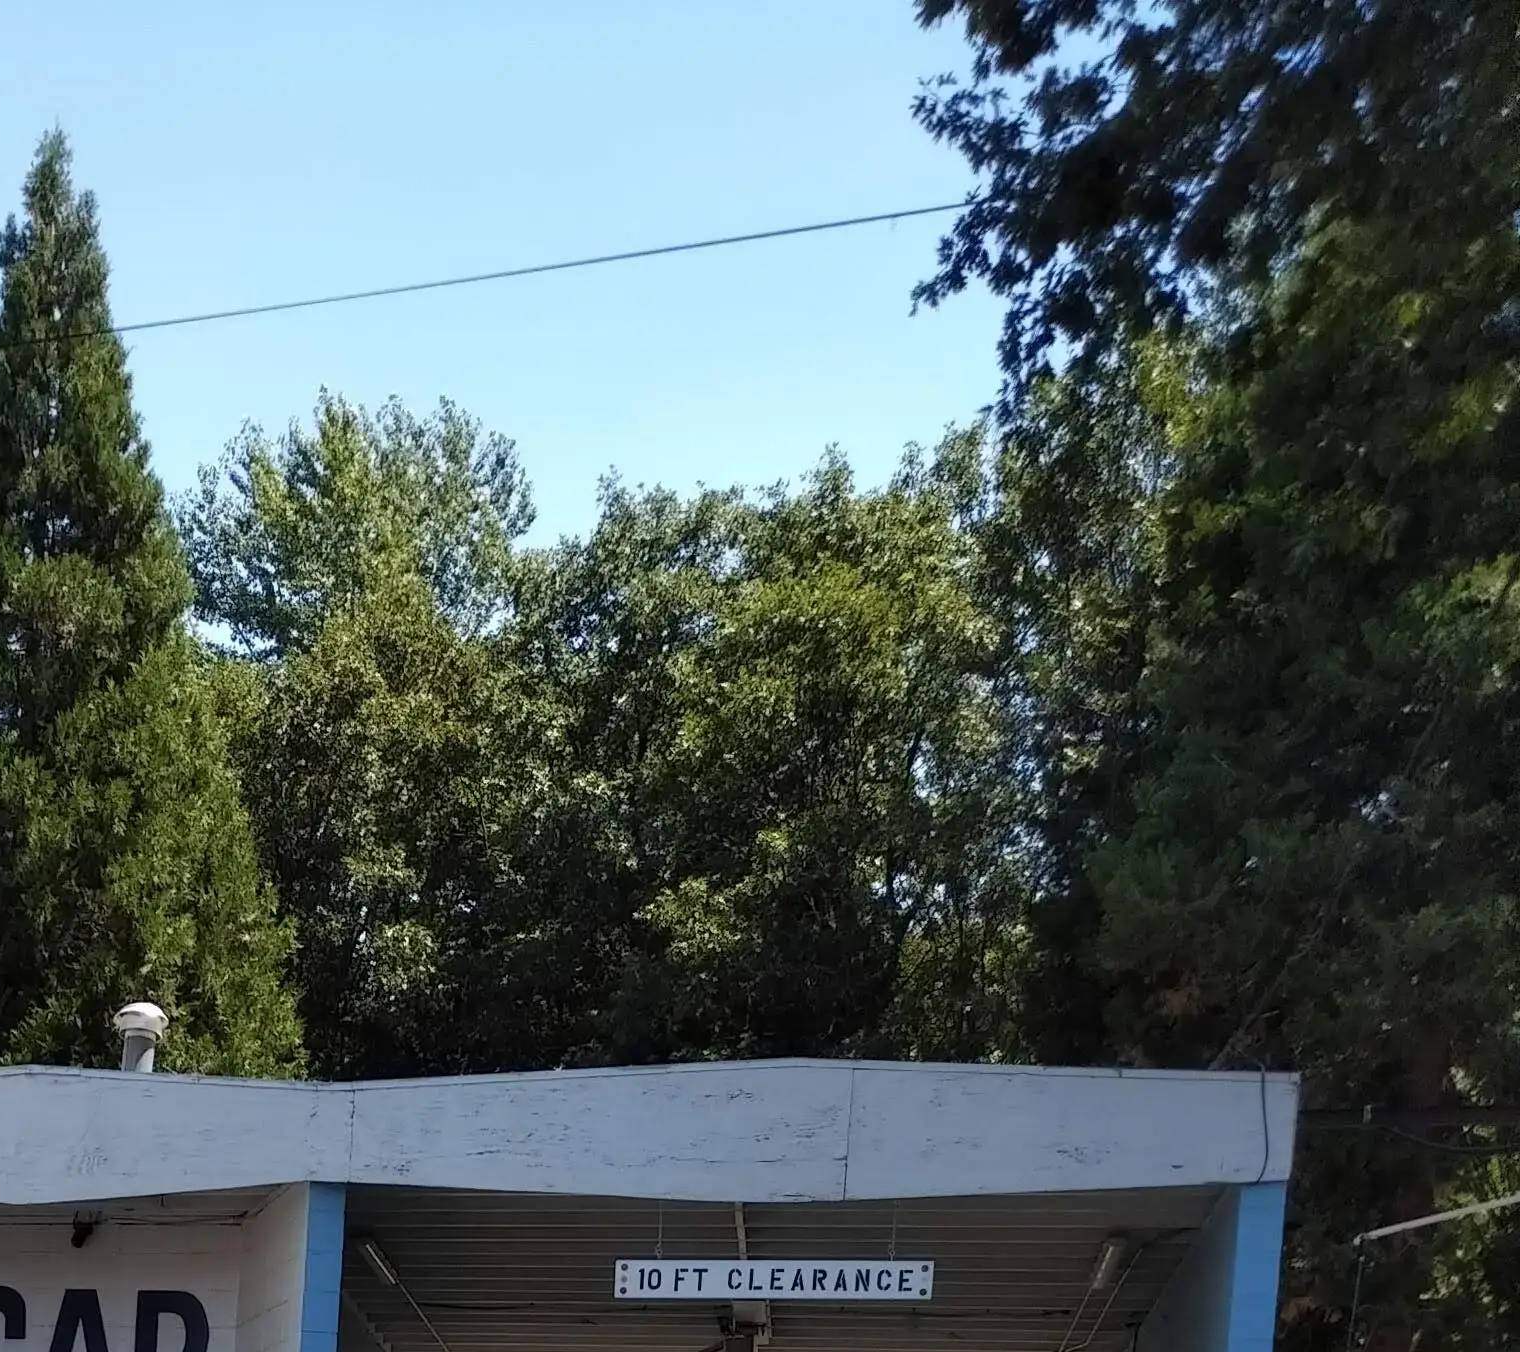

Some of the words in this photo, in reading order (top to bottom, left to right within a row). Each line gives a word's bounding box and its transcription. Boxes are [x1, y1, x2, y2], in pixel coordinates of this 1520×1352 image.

[638, 1268, 662, 1291] 10
[673, 1268, 709, 1292] FT
[727, 1268, 914, 1293] CLEARANCE
